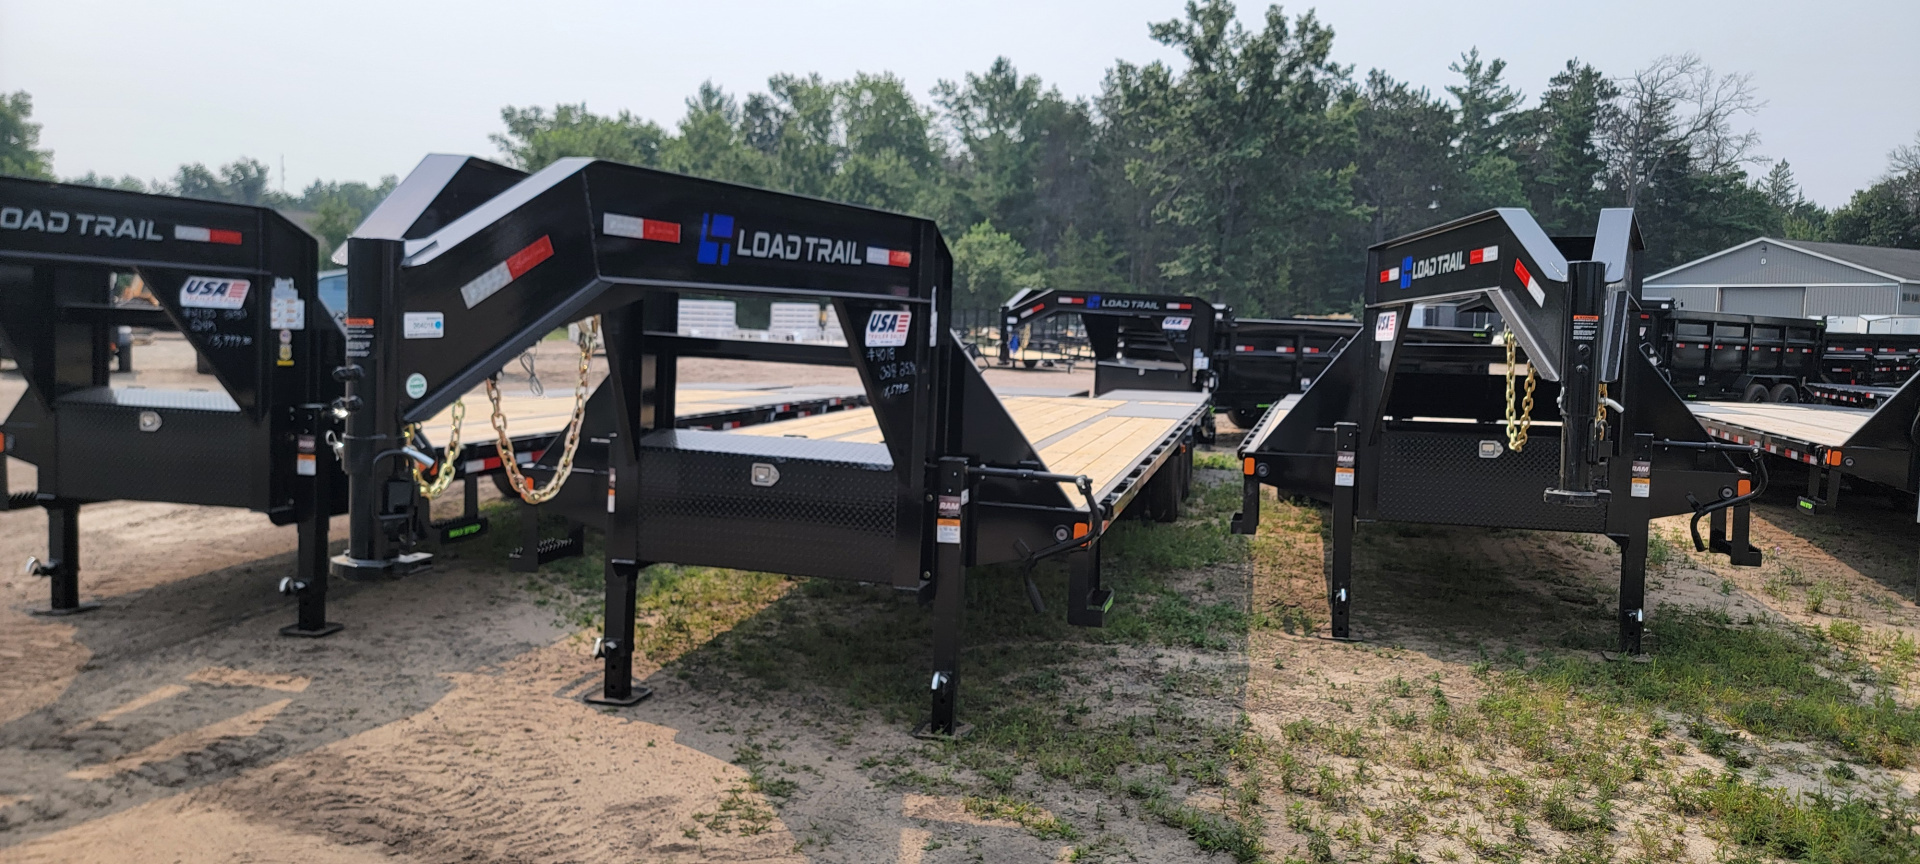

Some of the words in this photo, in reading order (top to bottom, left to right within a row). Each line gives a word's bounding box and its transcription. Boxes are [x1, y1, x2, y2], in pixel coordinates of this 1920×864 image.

[76, 213, 164, 242] TRAIL
[736, 229, 802, 261] LOAD
[805, 236, 862, 265] TRAIL
[1412, 257, 1437, 280] LOAD
[1437, 250, 1466, 275] TRAIL
[186, 280, 230, 297] USA
[1102, 300, 1130, 308] LOAD
[1131, 301, 1159, 309] TRAIL
[869, 314, 898, 333] USA
[1631, 465, 1650, 473] RAM
[939, 501, 960, 511] RAM
